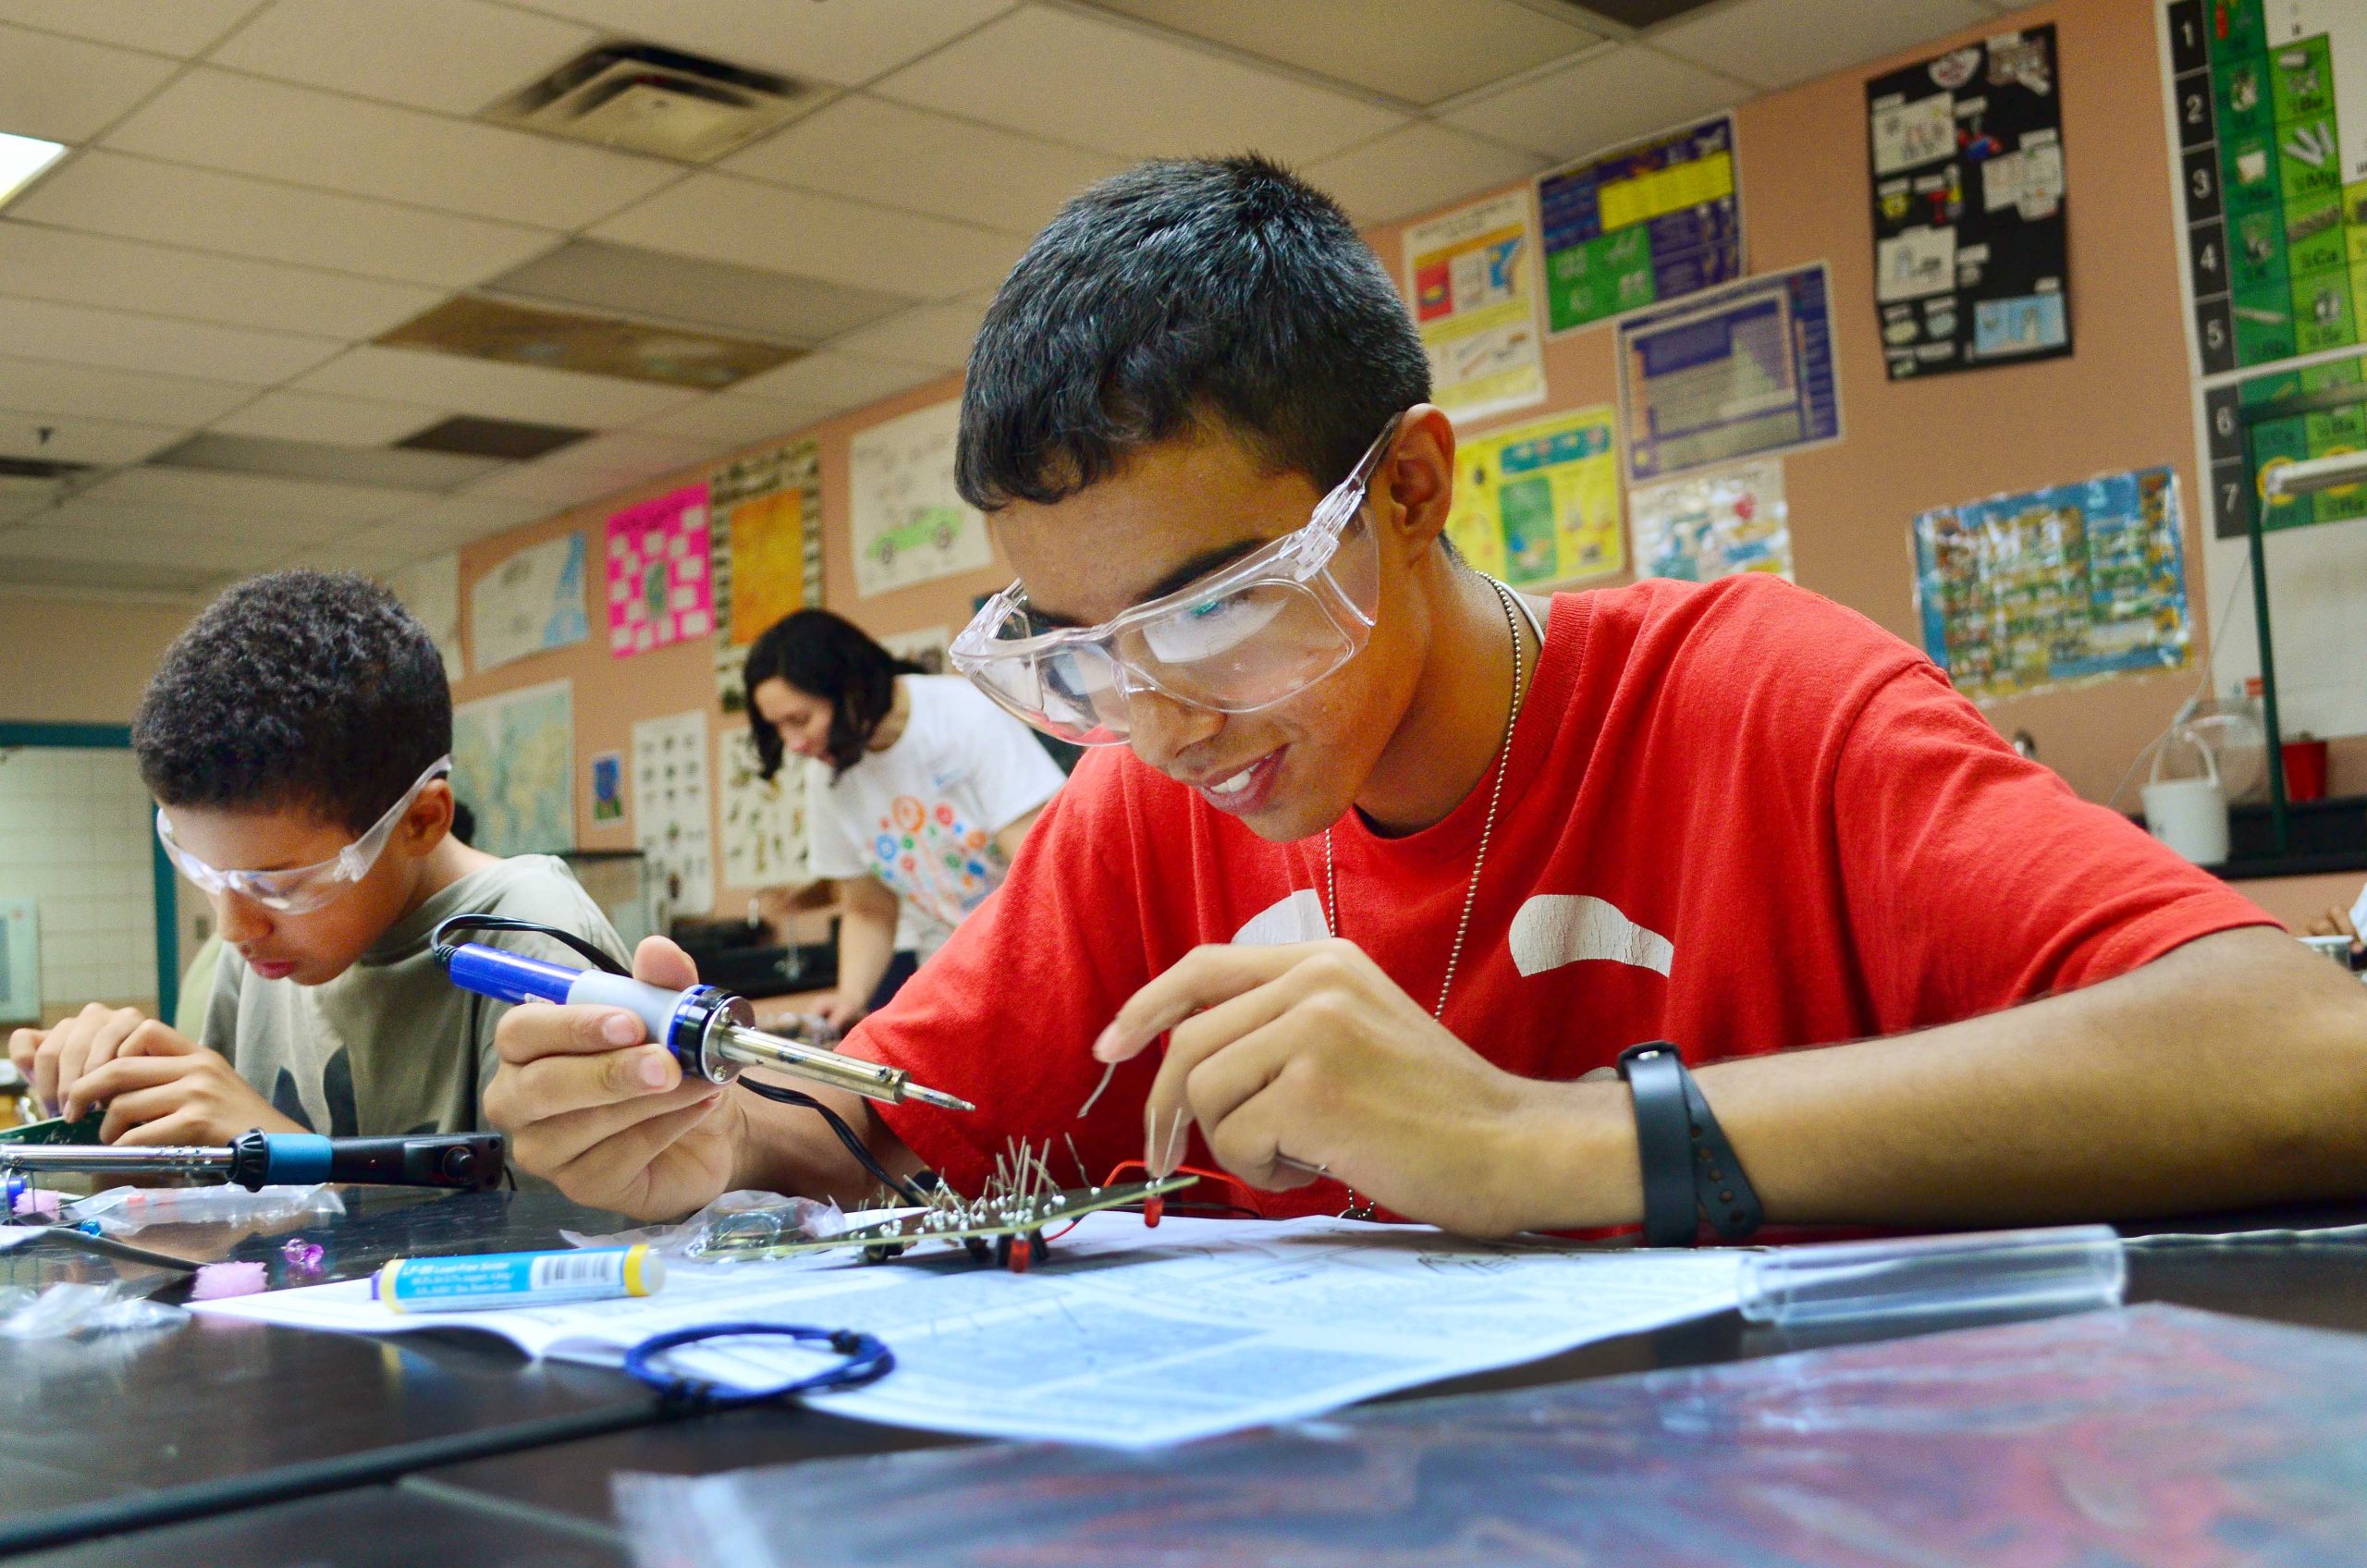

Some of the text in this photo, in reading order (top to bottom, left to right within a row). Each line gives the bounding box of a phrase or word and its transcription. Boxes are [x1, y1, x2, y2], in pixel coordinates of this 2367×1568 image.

[2181, 20, 2194, 48] 1
[2186, 93, 2203, 124] 2
[2192, 167, 2211, 199] 3
[2200, 243, 2217, 273] 4
[2207, 318, 2225, 349] 5
[2216, 406, 2234, 437] 6
[2222, 484, 2240, 513] 7
